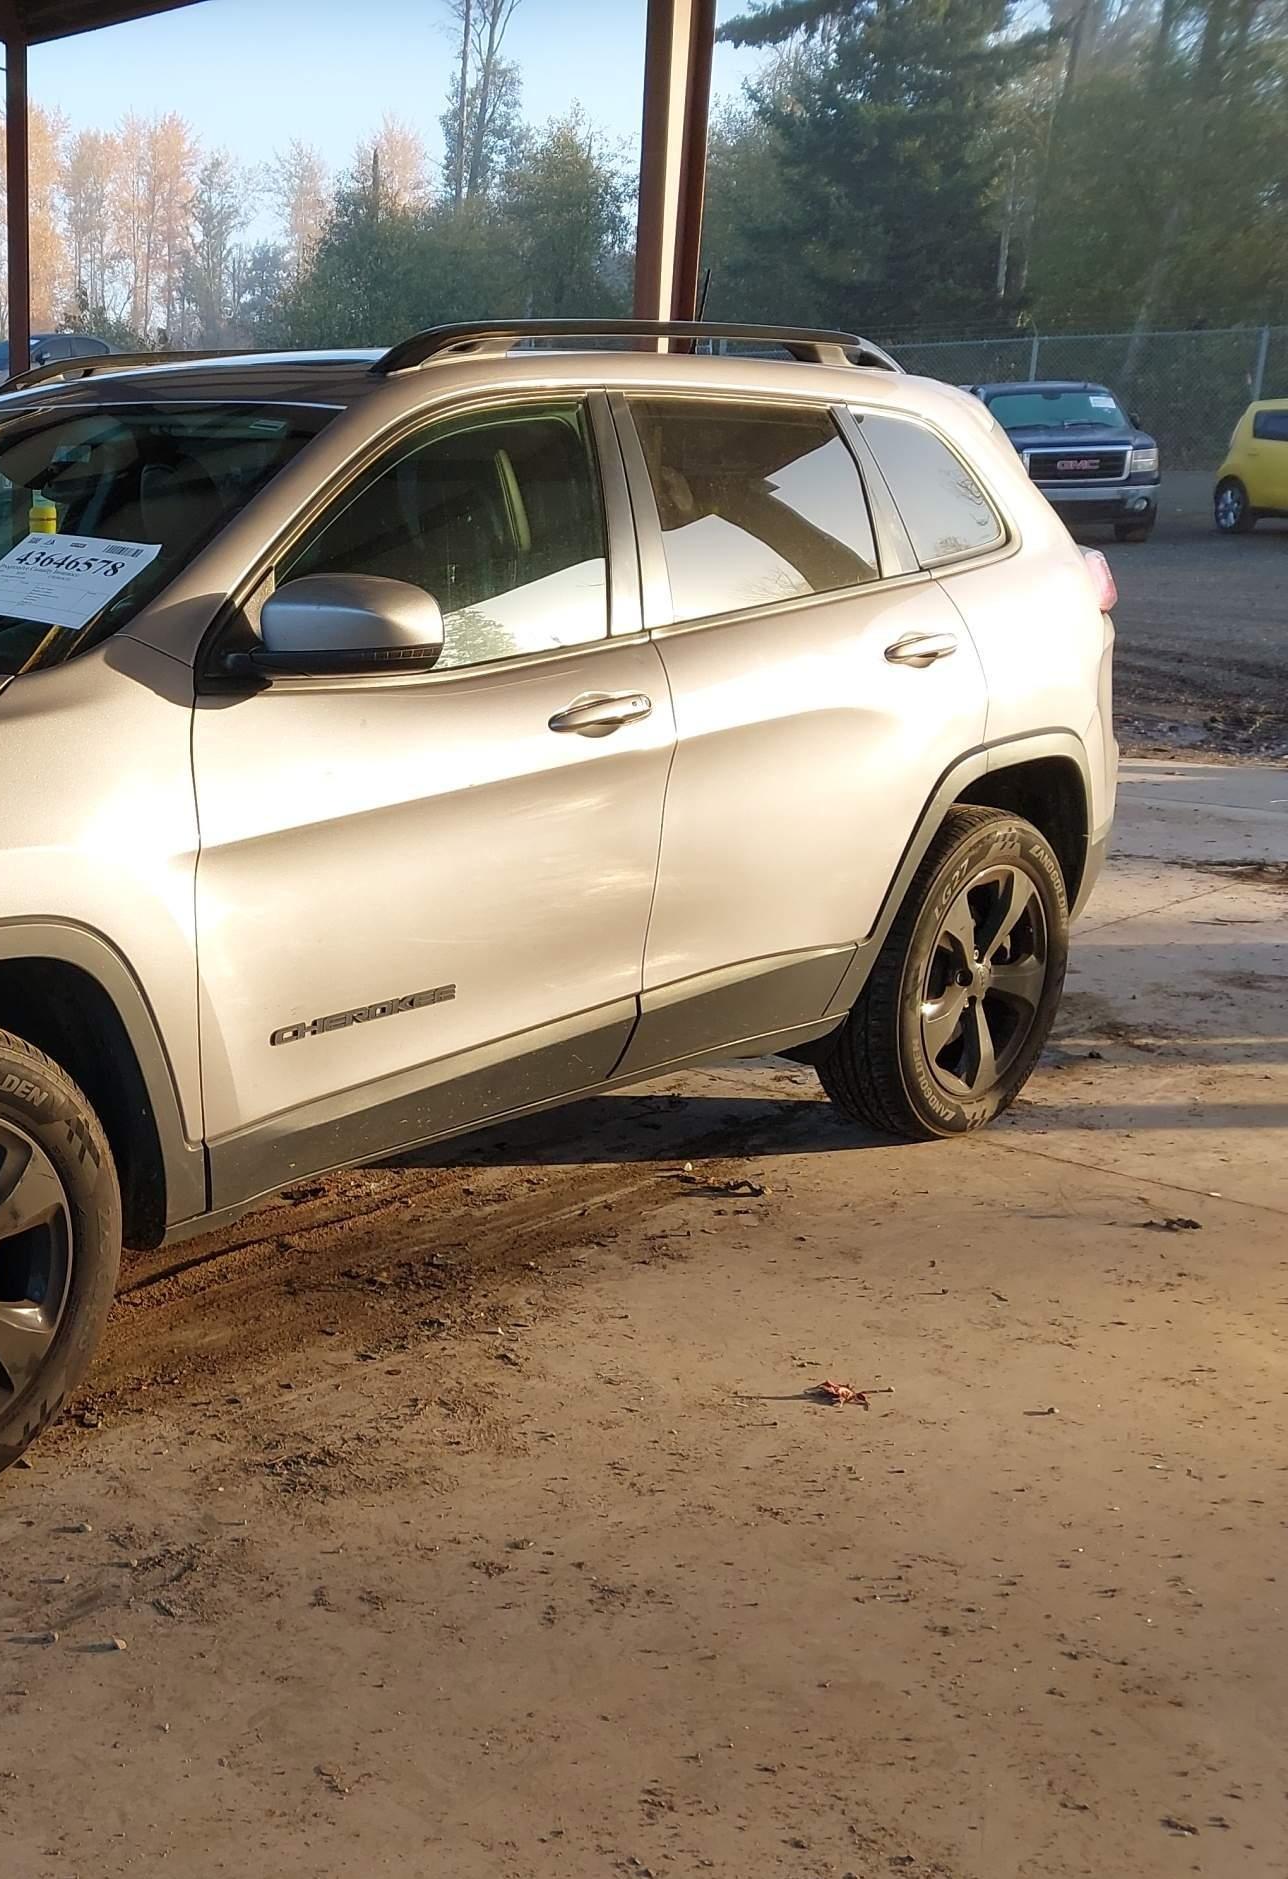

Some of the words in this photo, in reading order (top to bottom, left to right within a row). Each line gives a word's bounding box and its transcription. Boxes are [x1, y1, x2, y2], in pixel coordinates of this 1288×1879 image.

[1057, 459, 1100, 470] GMC
[15, 550, 127, 578] 43646578
[269, 983, 457, 1047] CHEROKEE
